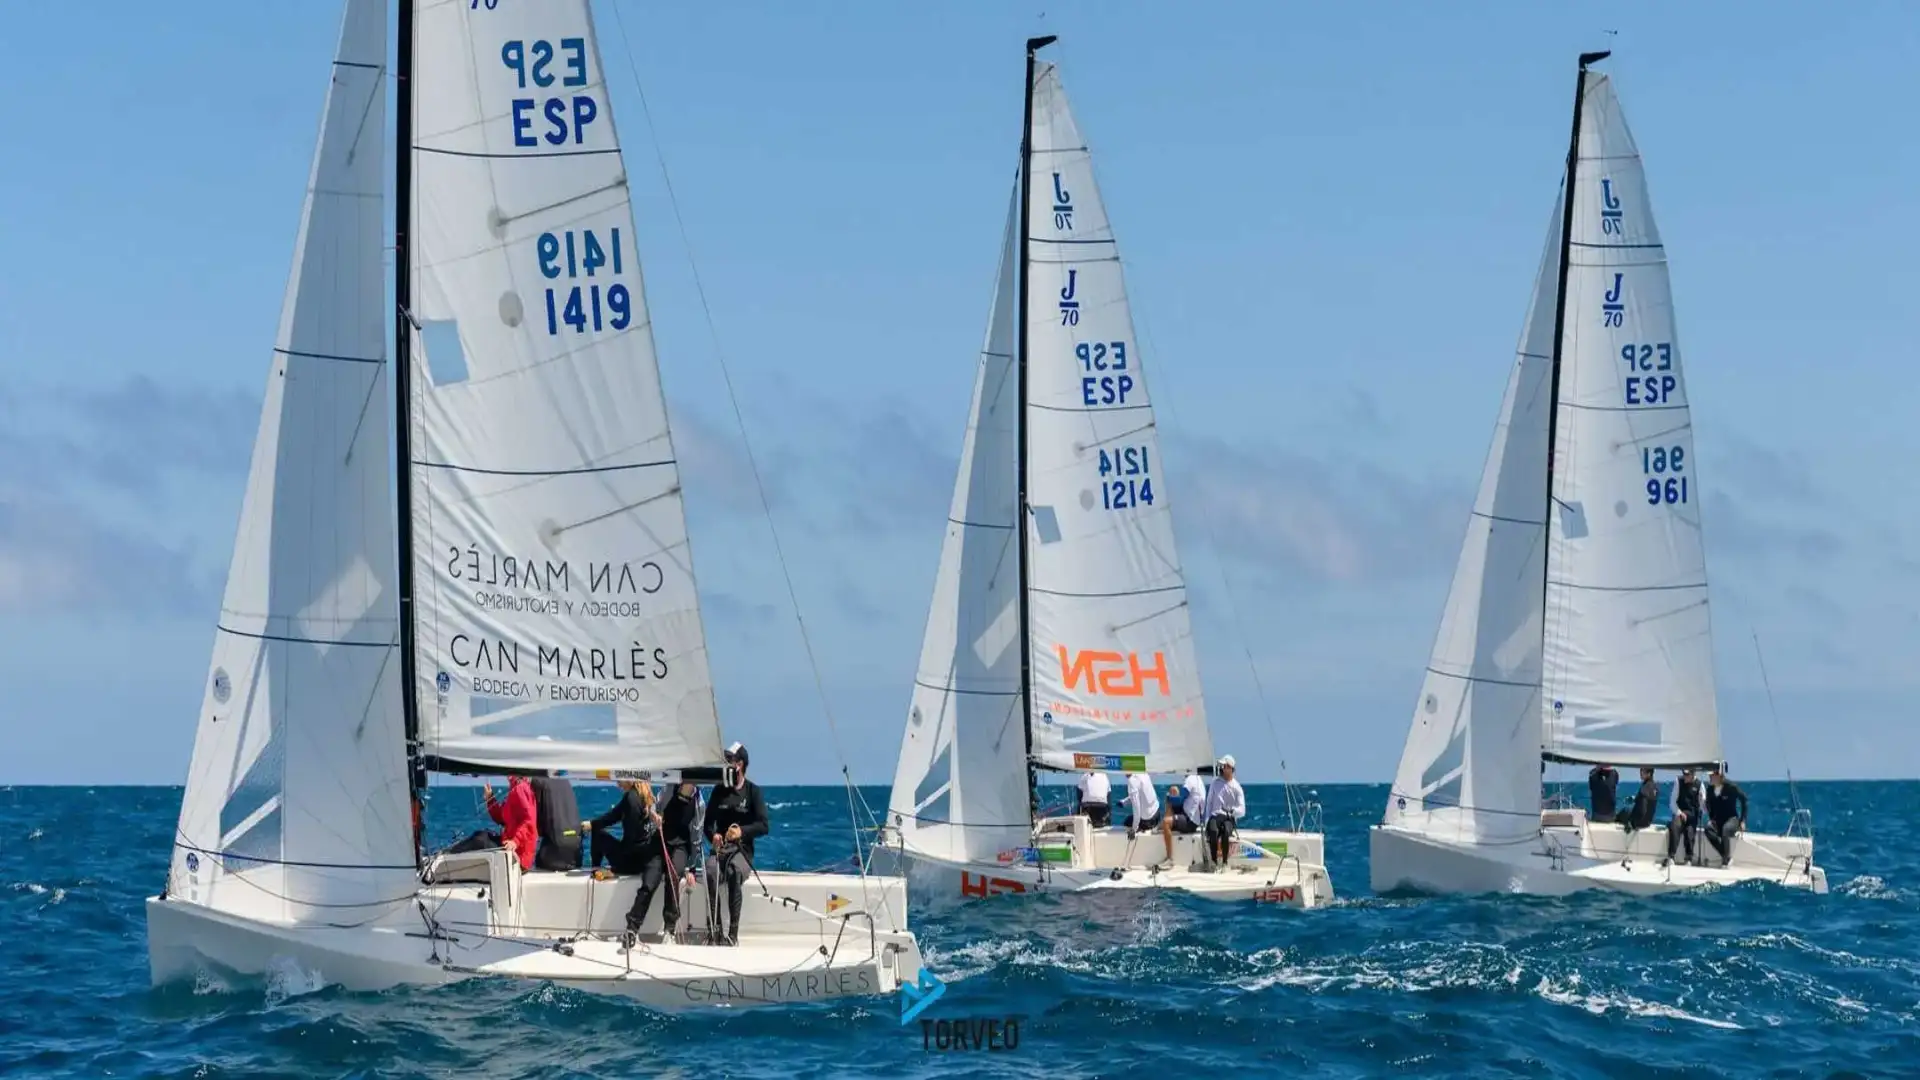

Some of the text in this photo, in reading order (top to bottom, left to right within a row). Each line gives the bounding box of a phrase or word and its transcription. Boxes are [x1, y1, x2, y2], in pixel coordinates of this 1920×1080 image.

[512, 96, 597, 147] ESP
[1061, 270, 1077, 300] J
[1604, 272, 1624, 303] J
[546, 284, 631, 335] 1419
[1060, 309, 1079, 326] 70
[1604, 310, 1624, 328] 70
[1082, 375, 1133, 405] ESP
[1626, 375, 1676, 404] ESP
[1102, 478, 1154, 510] 1214
[1646, 476, 1688, 505] 961
[450, 634, 668, 680] CAN MARLÈS
[473, 677, 640, 702] BODEGA Y ENOTURISMO
[684, 979, 745, 1001] CAN
